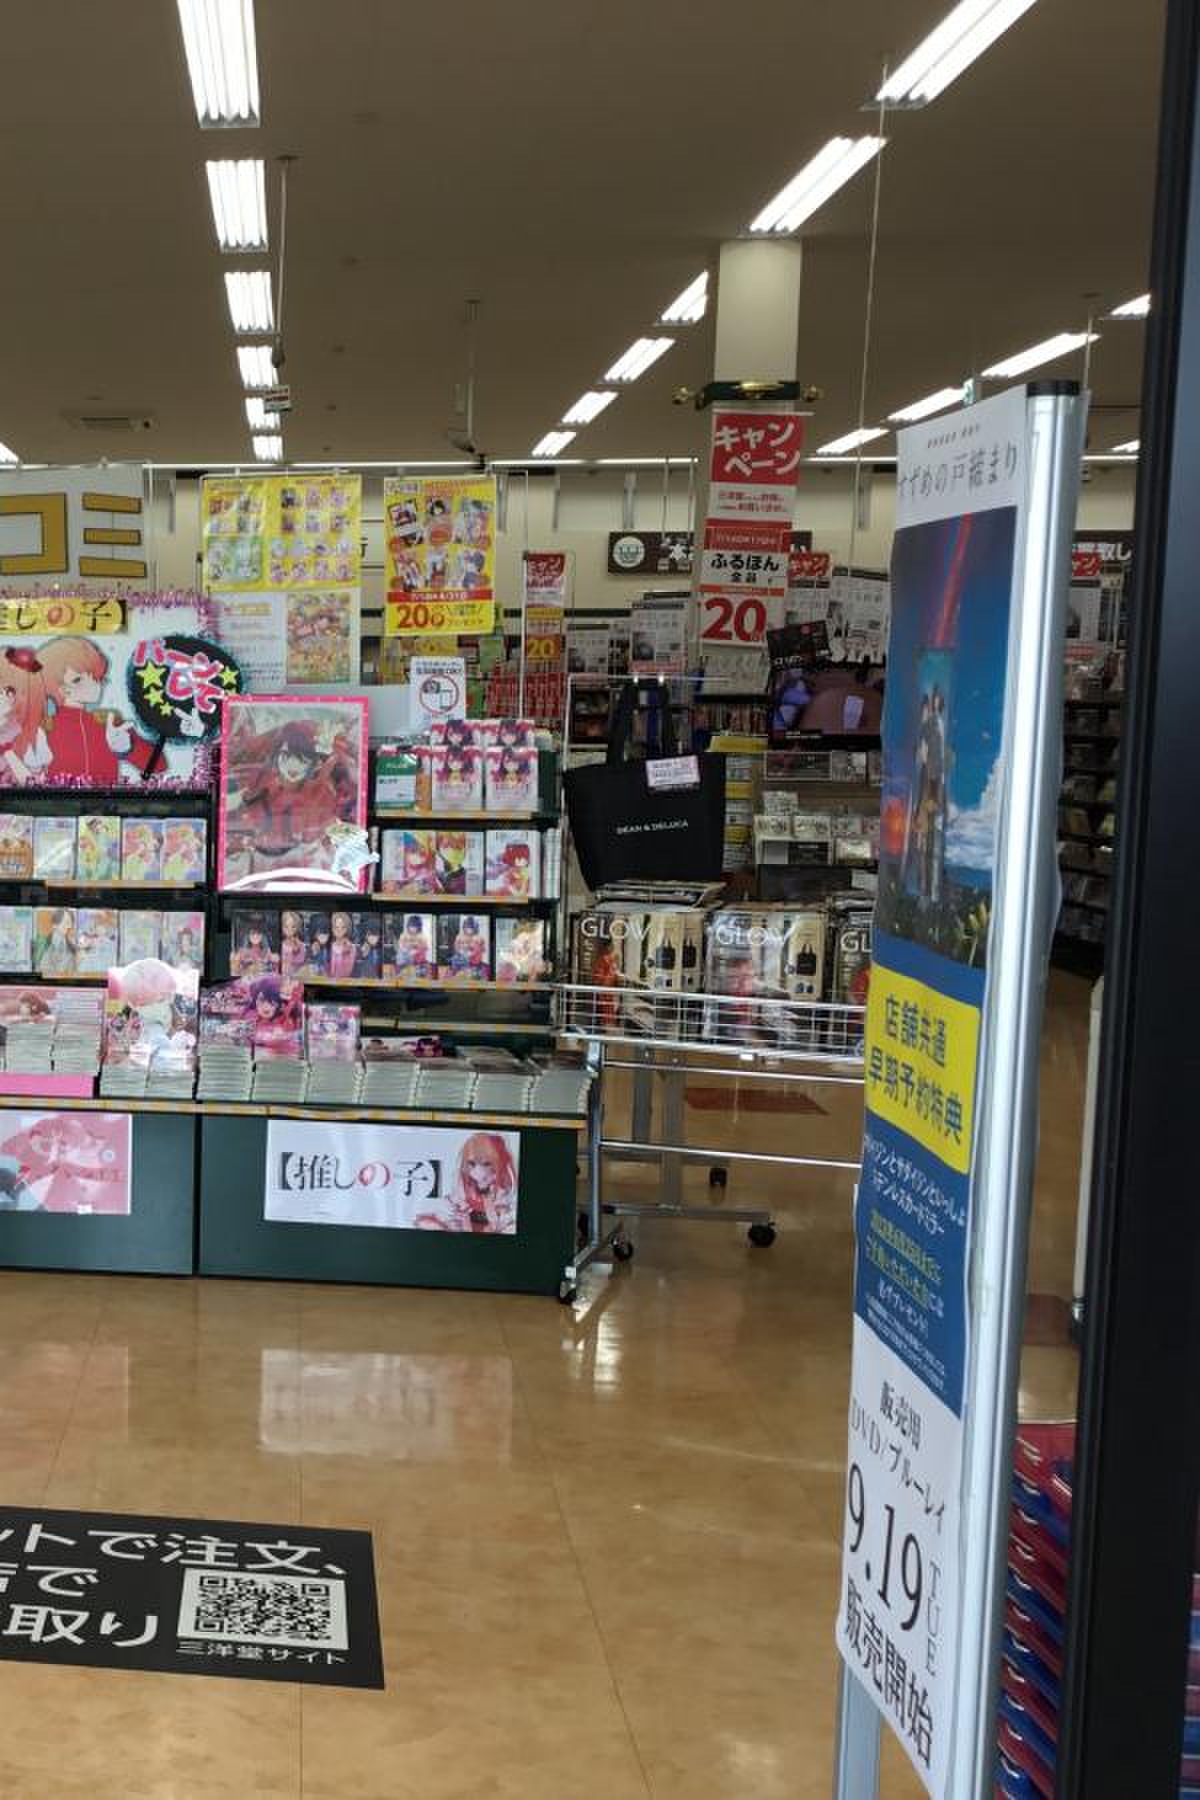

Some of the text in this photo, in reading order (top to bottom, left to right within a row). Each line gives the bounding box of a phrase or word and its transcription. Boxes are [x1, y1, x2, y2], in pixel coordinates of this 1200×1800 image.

[714, 423, 795, 452] キャン
[724, 451, 801, 477] ペーン
[711, 553, 779, 571] ふるほん
[702, 597, 767, 642] 20
[886, 993, 946, 1068] 店舗共通
[868, 1046, 963, 1146] 早期予約特典
[279, 1152, 442, 1199] 【推しの子】
[880, 1381, 921, 1451] 販売用
[847, 1463, 923, 1633] 9.19
[176, 1640, 346, 1665] 三洋堂サイト
[846, 1578, 934, 1768] 販売開始
